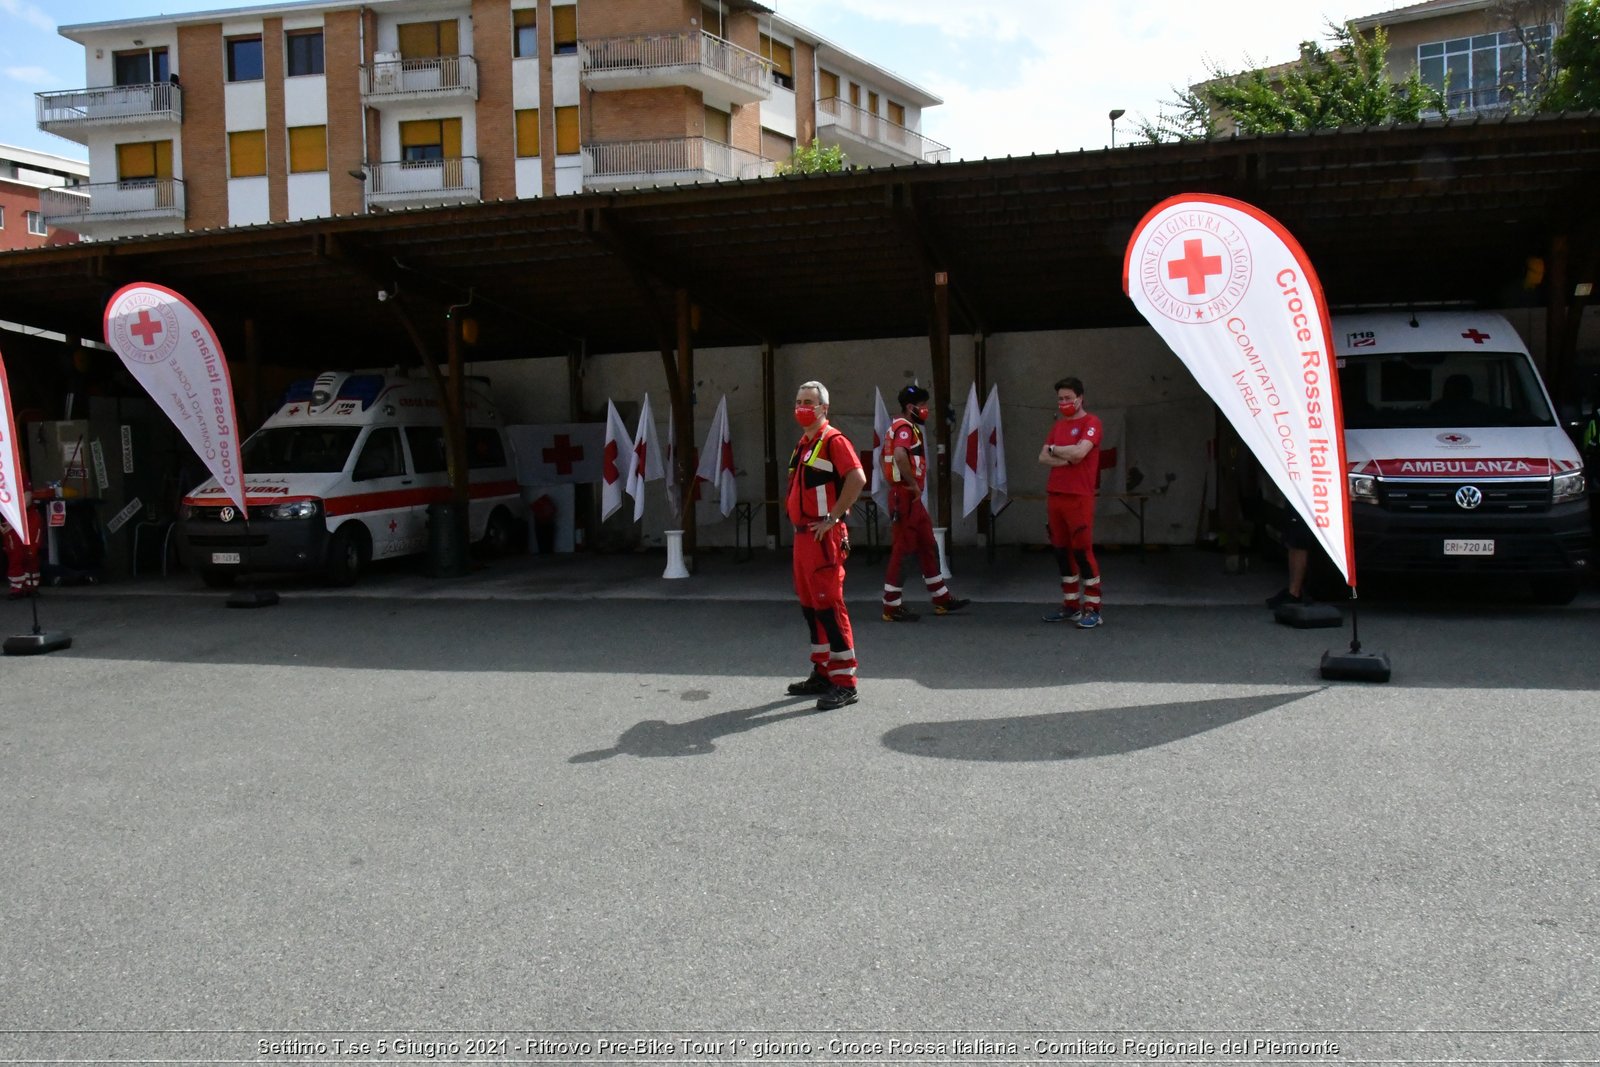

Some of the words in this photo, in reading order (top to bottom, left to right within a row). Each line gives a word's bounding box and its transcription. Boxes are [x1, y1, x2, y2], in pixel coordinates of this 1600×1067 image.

[1152, 231, 1169, 247] DI
[1166, 214, 1222, 234] GINEVRA
[1224, 230, 1240, 247] 22
[1144, 248, 1191, 319] CONVENZIONE
[1230, 247, 1249, 297] AGOSTO
[1208, 296, 1232, 318] 1864
[1276, 268, 1312, 342] Croce
[1350, 331, 1374, 339] 118
[1227, 317, 1280, 407] COMITATO
[1273, 411, 1302, 482] LOCALE
[1232, 370, 1262, 418] IVREA
[1301, 350, 1323, 430] Rossa
[1309, 439, 1332, 530] Italiana
[1401, 460, 1530, 473] AMBULANZA
